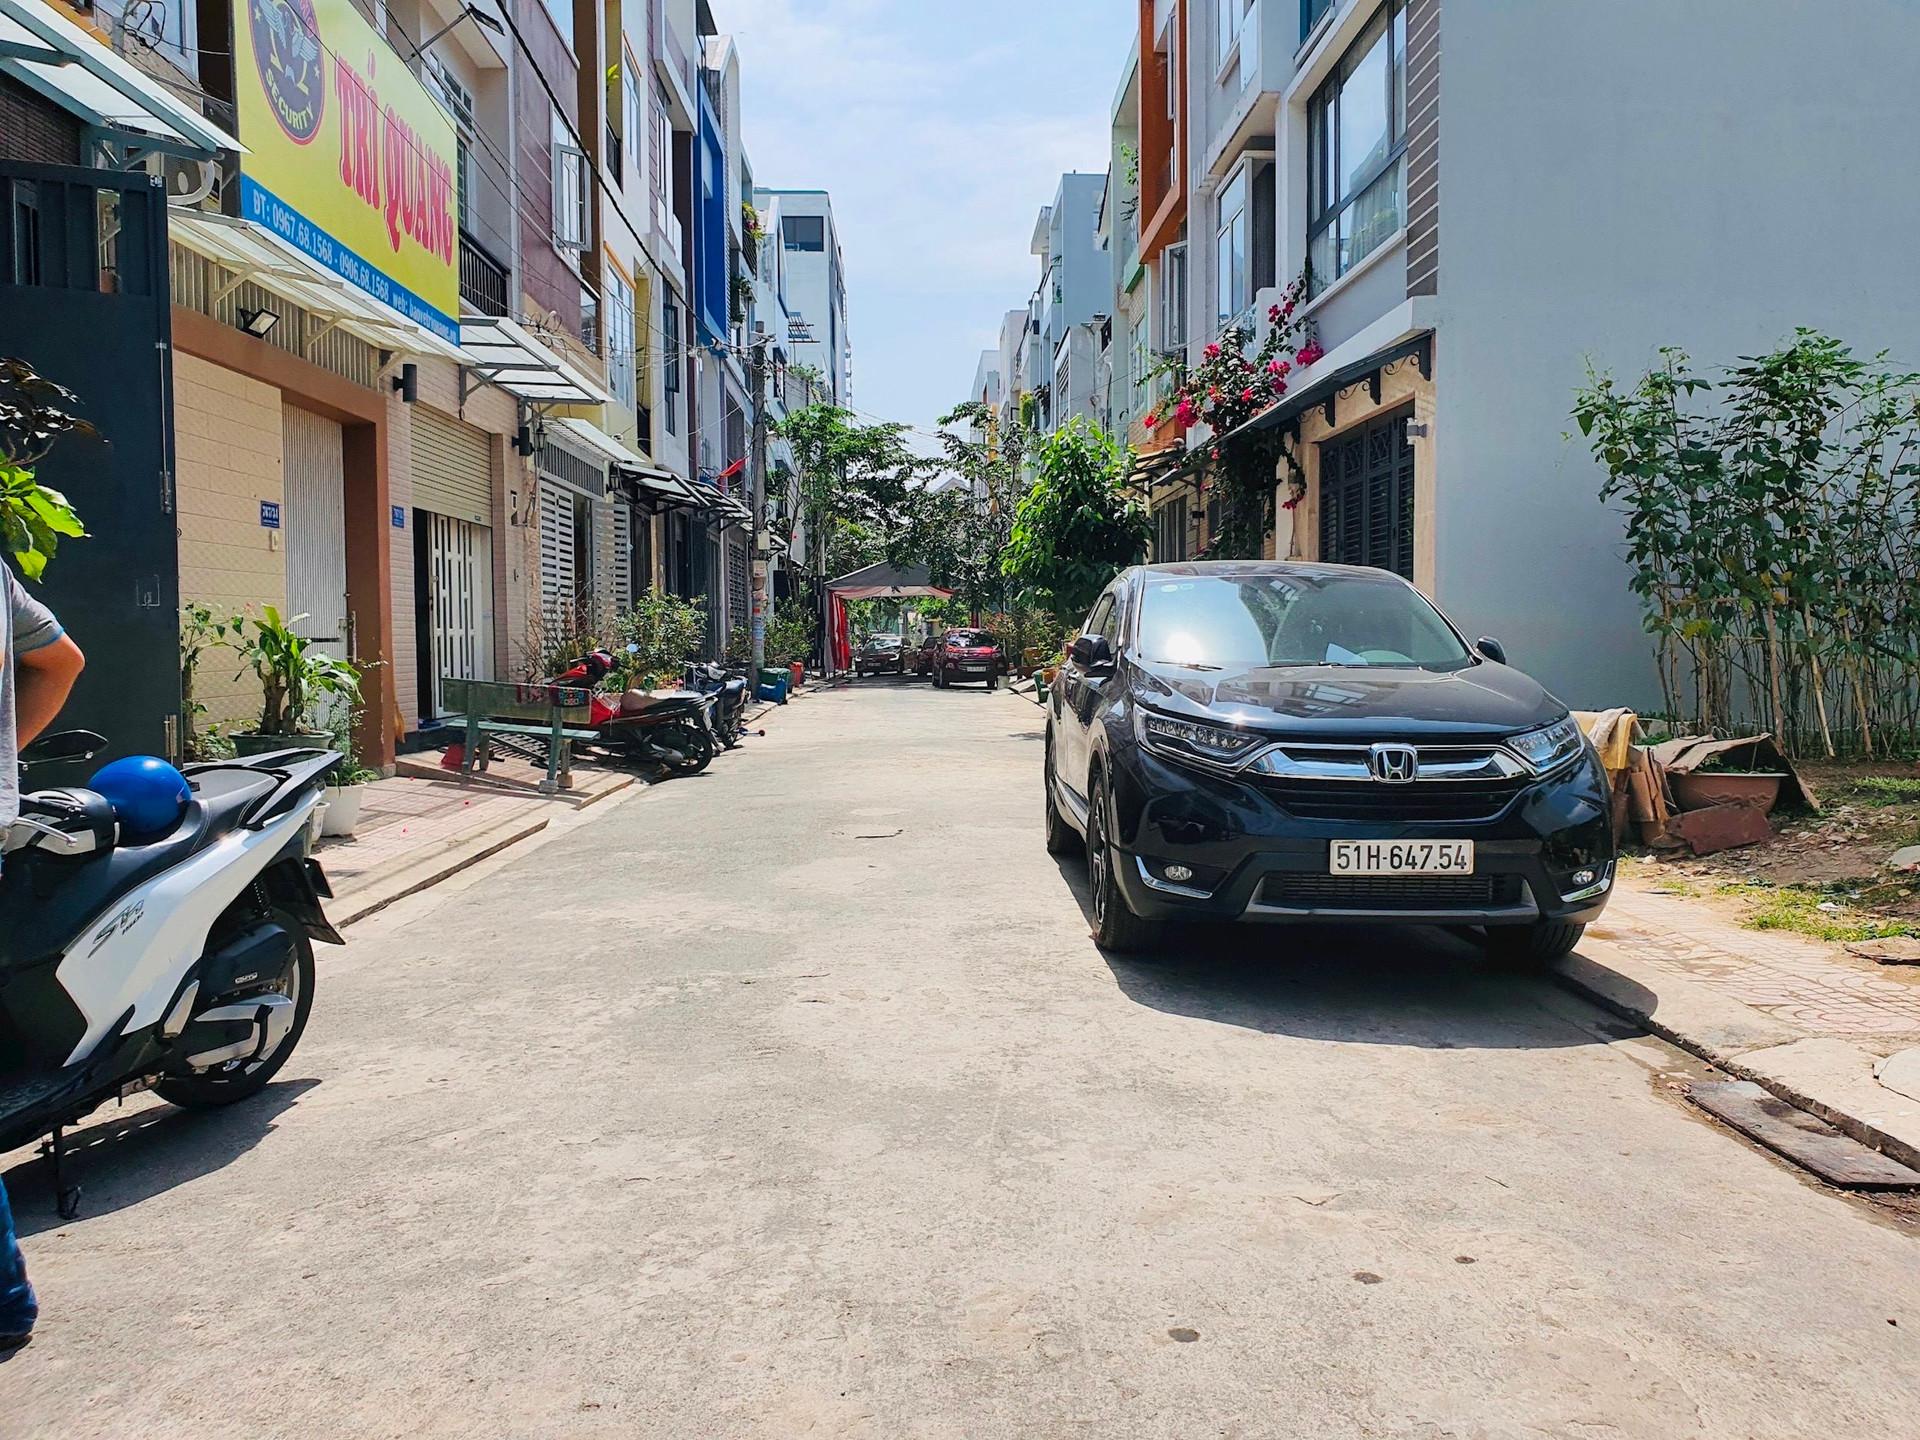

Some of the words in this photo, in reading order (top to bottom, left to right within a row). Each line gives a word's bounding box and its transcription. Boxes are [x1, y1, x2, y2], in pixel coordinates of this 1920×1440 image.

[265, 68, 314, 130] SECURITY
[383, 103, 454, 267] QUANG
[272, 202, 334, 266] 0967.68.1568
[339, 251, 390, 304] 0906.68.1568
[1336, 844, 1467, 871] 51H-647.54
